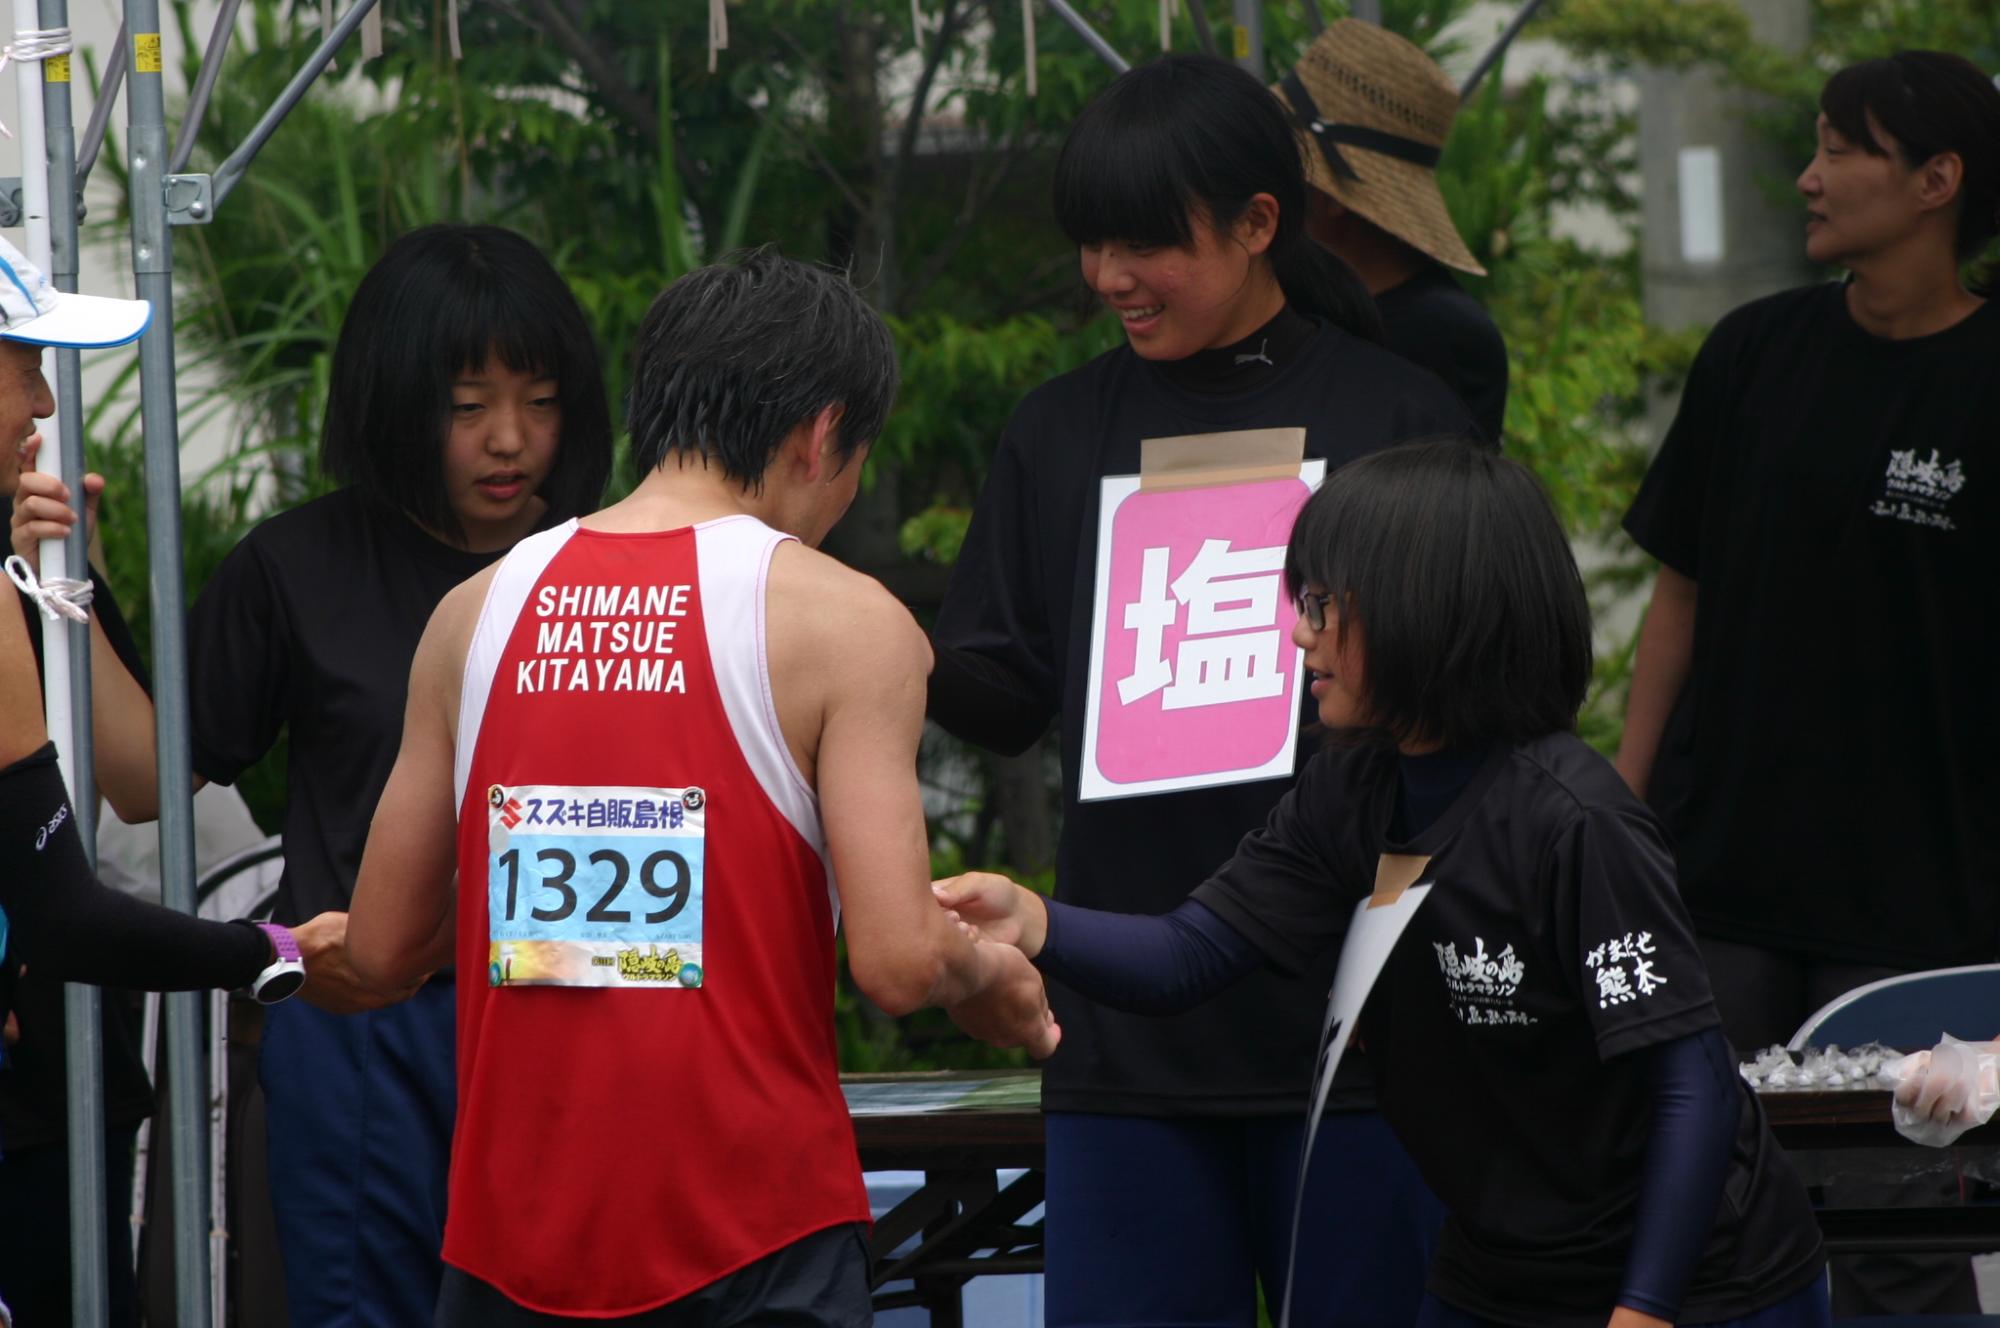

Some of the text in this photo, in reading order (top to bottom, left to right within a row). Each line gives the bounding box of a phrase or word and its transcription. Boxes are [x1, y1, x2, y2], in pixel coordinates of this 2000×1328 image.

[536, 585, 691, 616] SHIMANE
[536, 621, 677, 654] MATSUE
[1117, 538, 1288, 711] 塩
[516, 658, 687, 694] KITAYAMA
[526, 798, 685, 829] スズキ自販島根
[499, 848, 691, 924] 1329
[1585, 931, 1656, 968] がまだせ
[1596, 956, 1667, 1009] 熊本
